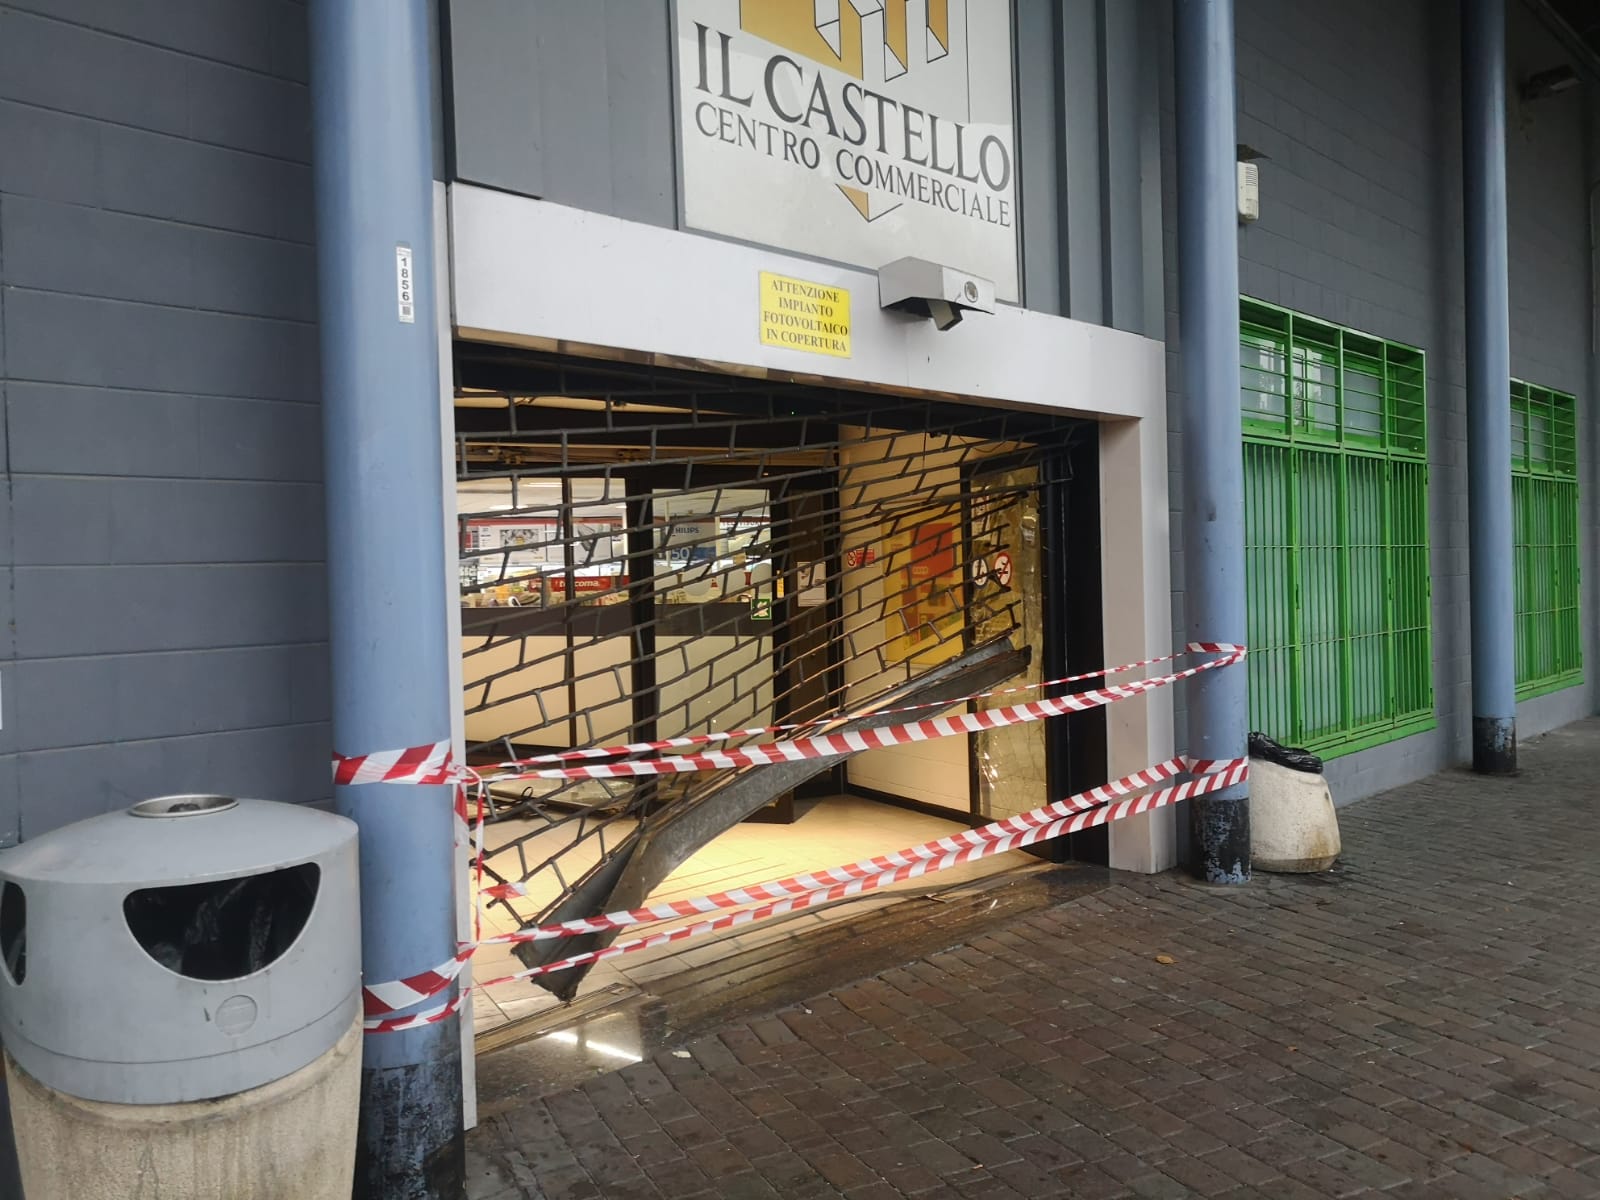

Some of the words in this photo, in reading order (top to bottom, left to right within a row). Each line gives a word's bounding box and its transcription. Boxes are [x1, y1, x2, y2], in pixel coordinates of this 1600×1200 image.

[693, 21, 754, 108] IL
[764, 55, 1011, 192] CASTELLO
[695, 101, 820, 170] CENTRO
[836, 148, 1011, 228] COMMERCIALE
[401, 257, 410, 301] 1856
[771, 280, 840, 303] ATTENZIONE
[779, 297, 833, 317] IMPIANTO
[763, 311, 848, 336] FOTOVOLTAICO
[766, 328, 778, 340] IN
[781, 330, 846, 352] COPERTURA
[674, 526, 699, 534] HILIPS
